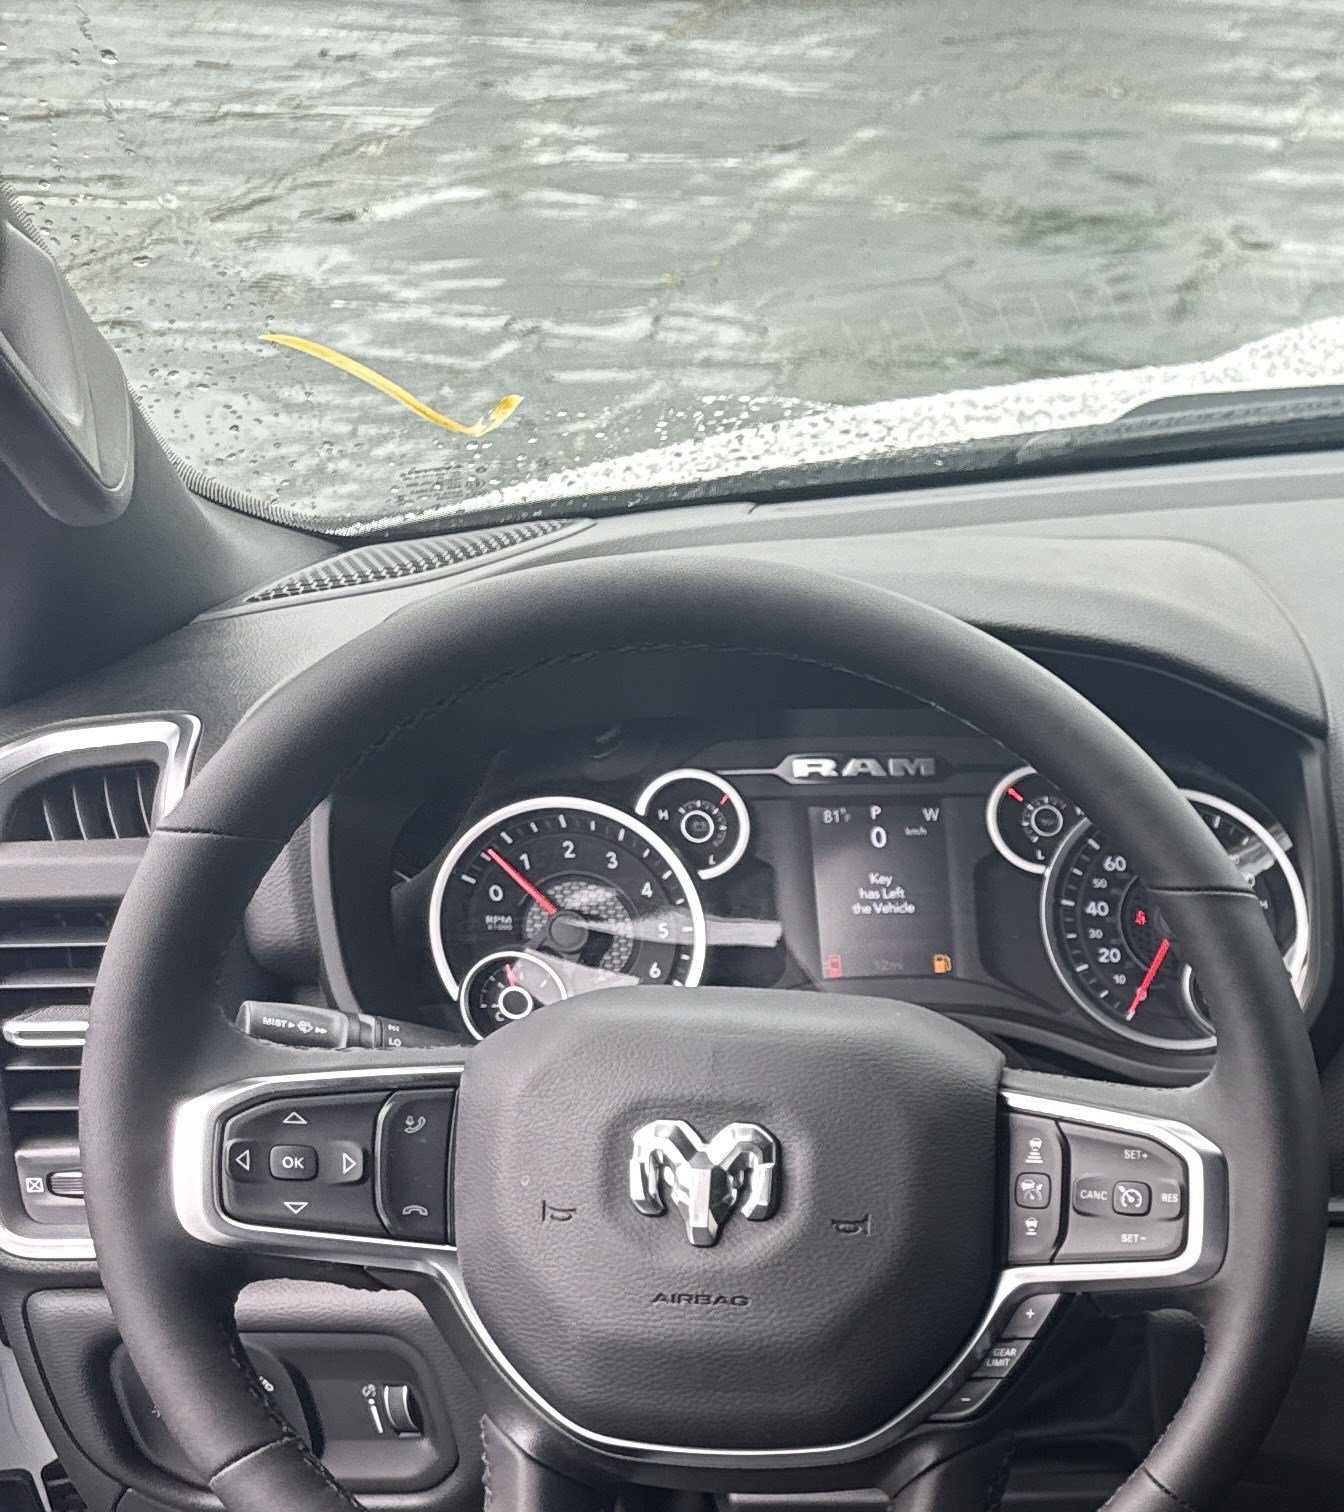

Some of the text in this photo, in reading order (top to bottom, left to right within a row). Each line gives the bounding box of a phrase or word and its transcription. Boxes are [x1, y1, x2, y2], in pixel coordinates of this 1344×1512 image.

[791, 758, 937, 778] RAM
[869, 805, 881, 820] P
[922, 807, 940, 821] W
[869, 826, 887, 848] 0
[562, 840, 576, 859] 2
[519, 853, 530, 870] 1
[606, 852, 619, 869] 3
[1104, 856, 1126, 872] 60
[869, 873, 892, 886] Key
[488, 884, 503, 901] 0
[641, 882, 652, 898] 4
[874, 902, 916, 914] Vehicle
[1086, 901, 1109, 917] 40
[658, 922, 668, 938] 5
[1098, 947, 1121, 963] 20
[649, 961, 661, 979] 6
[282, 1156, 304, 1169] OK
[1162, 1193, 1179, 1203] RES
[651, 1293, 750, 1306] AIRBAG
